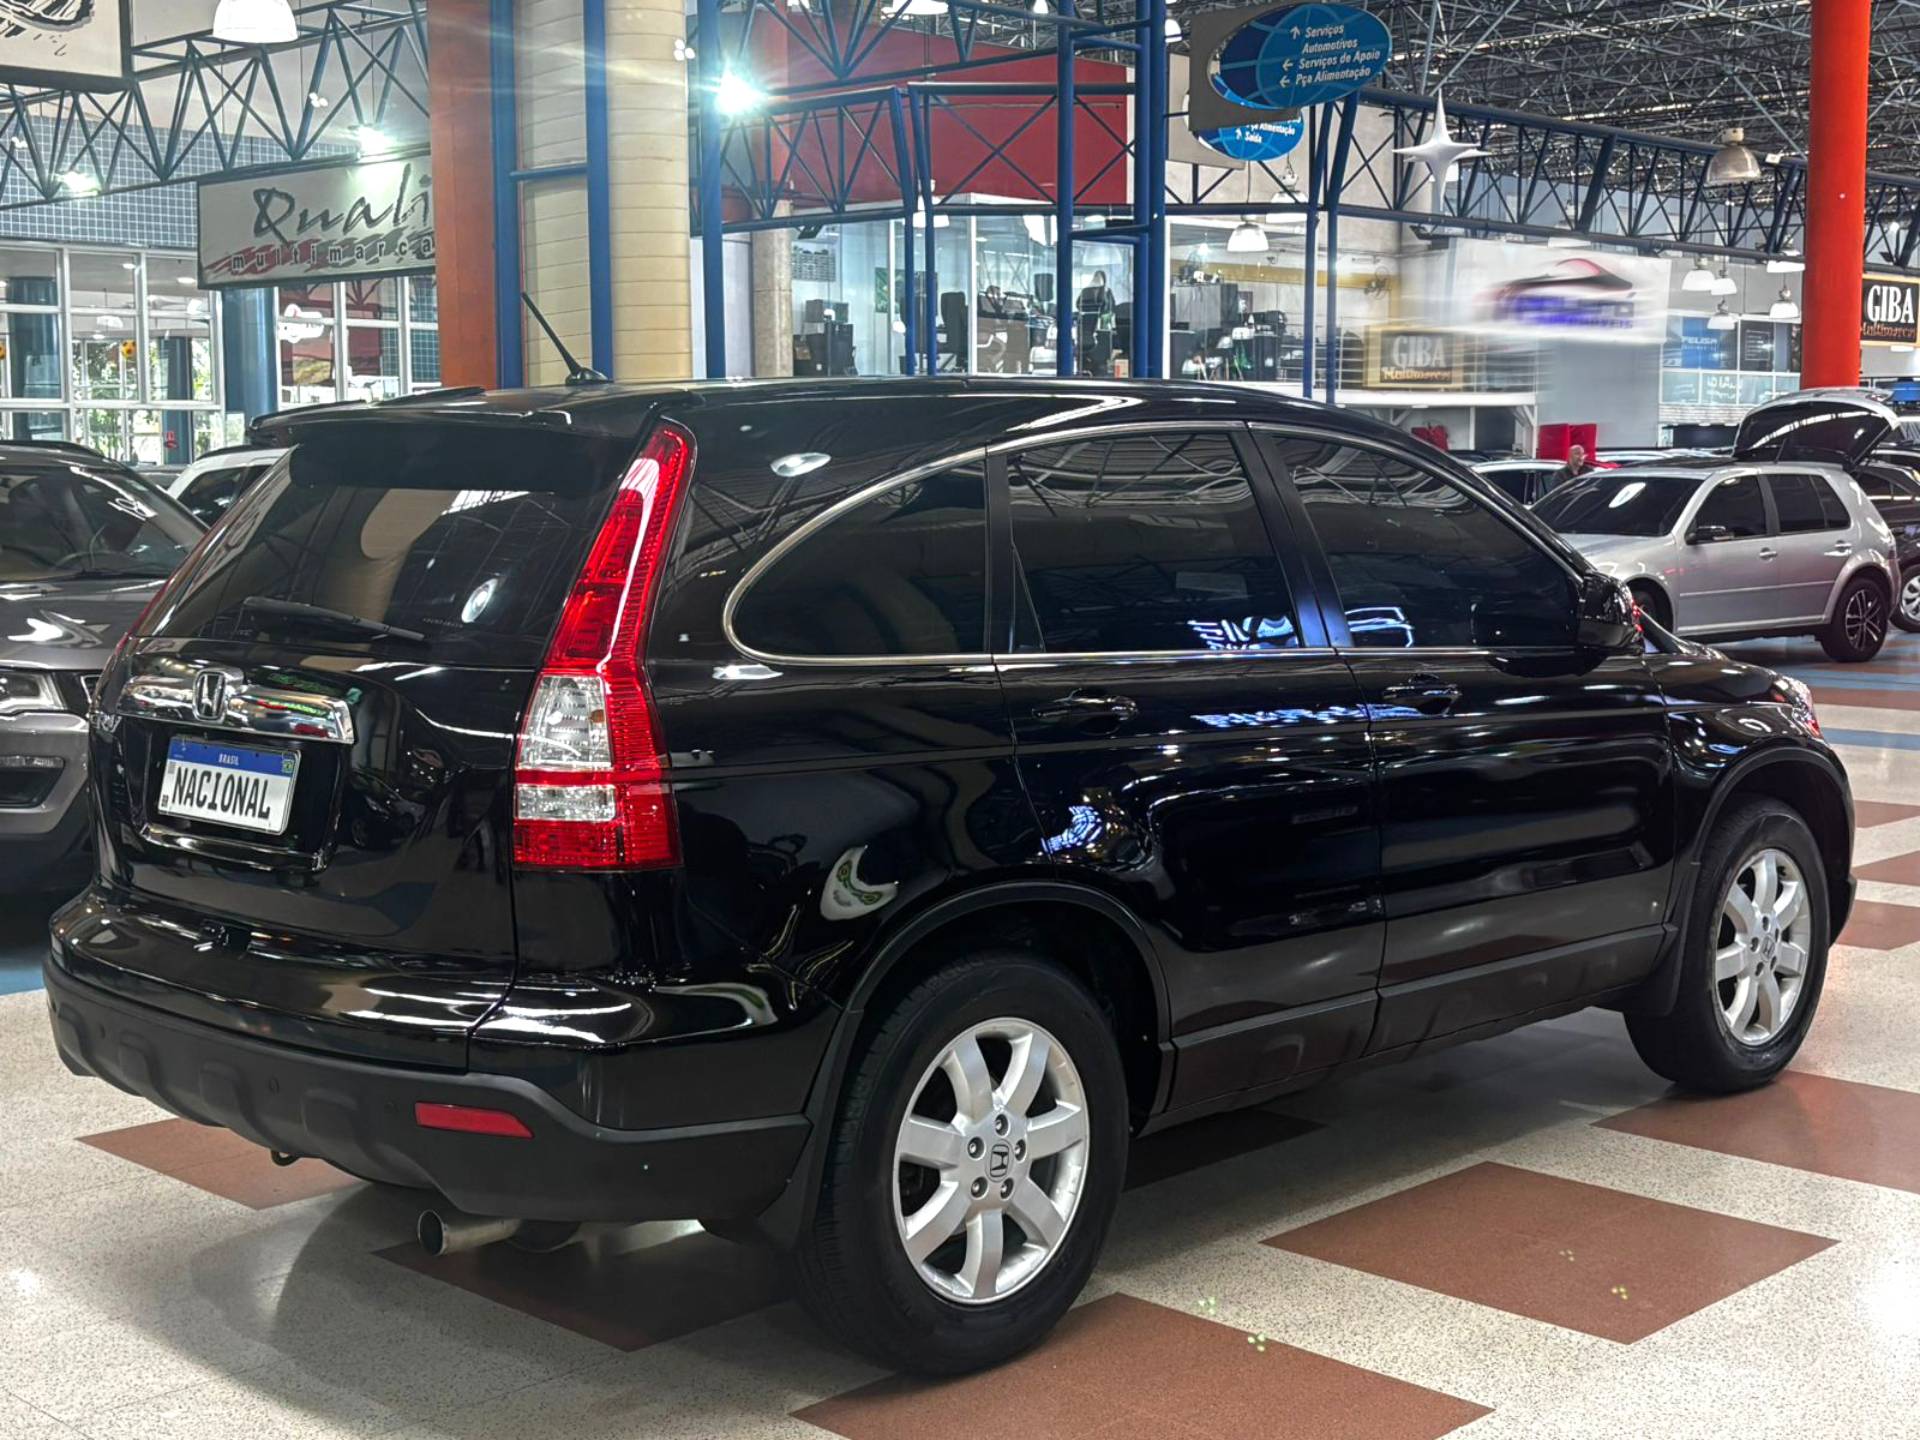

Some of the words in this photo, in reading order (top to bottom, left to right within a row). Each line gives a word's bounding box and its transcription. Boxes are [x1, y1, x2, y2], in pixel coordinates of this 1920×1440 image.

[1305, 24, 1344, 38] Serviços
[1302, 39, 1358, 54] Automotivos
[1299, 56, 1338, 69] Serviços
[1340, 52, 1351, 64] de
[1353, 49, 1380, 63] Apoio
[1296, 73, 1312, 87] Pça
[1314, 66, 1371, 83] Alimentação
[1867, 284, 1915, 323] GIBA
[1392, 335, 1447, 368] GIBA
[218, 753, 240, 766] BRASIL
[172, 766, 270, 820] NACIONAL
